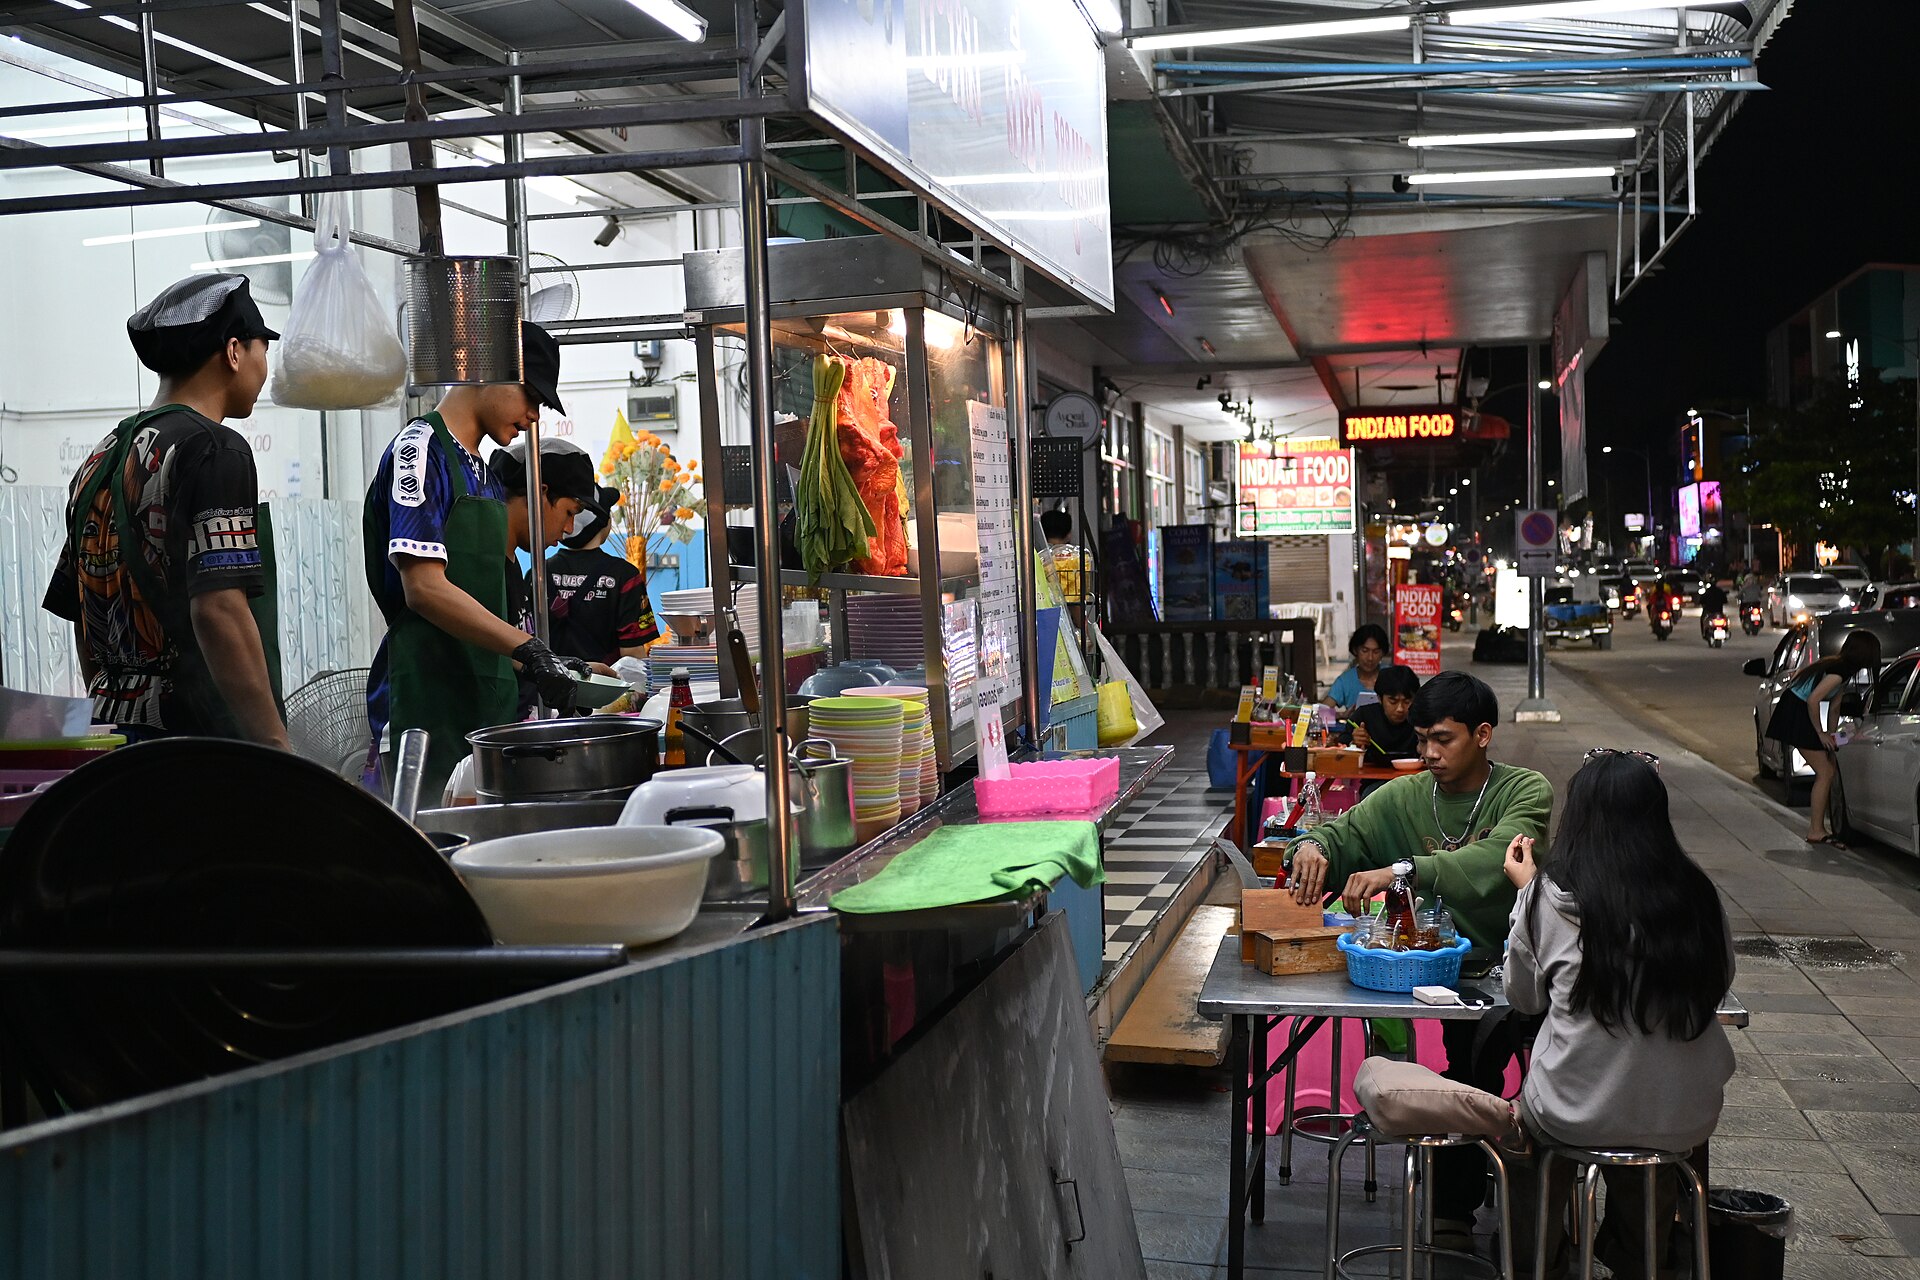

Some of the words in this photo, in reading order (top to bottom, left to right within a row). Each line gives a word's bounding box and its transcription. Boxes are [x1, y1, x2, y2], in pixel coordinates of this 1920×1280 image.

[1345, 416, 1407, 441] INDIAN
[1409, 414, 1454, 438] FOOD
[1241, 457, 1298, 486] INDIAN
[1302, 455, 1350, 485] FOOD
[1168, 528, 1200, 537] CORAL
[1396, 590, 1441, 604] INDIAN
[1401, 603, 1437, 617] FOOD
